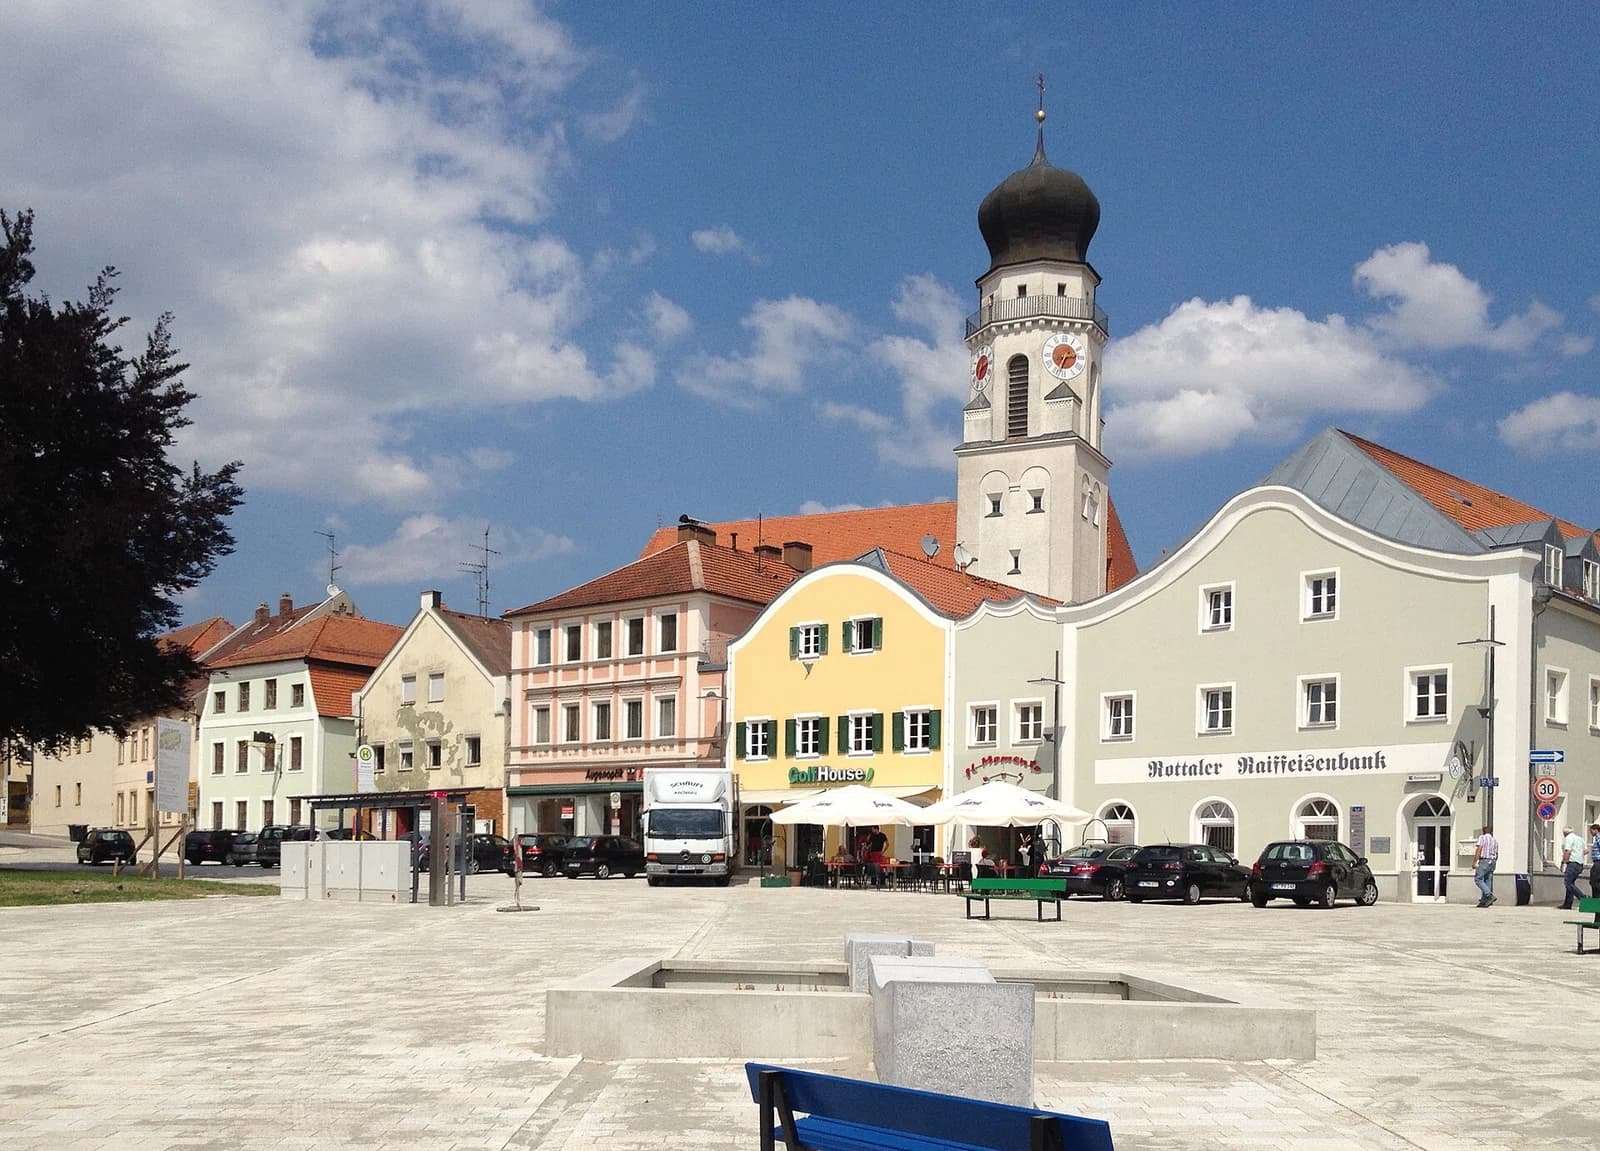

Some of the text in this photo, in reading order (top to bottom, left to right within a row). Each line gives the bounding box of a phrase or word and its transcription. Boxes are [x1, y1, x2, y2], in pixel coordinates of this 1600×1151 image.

[1148, 751, 1387, 778] Rottaler Raiffeisenbank
[1539, 783, 1554, 795] 30
